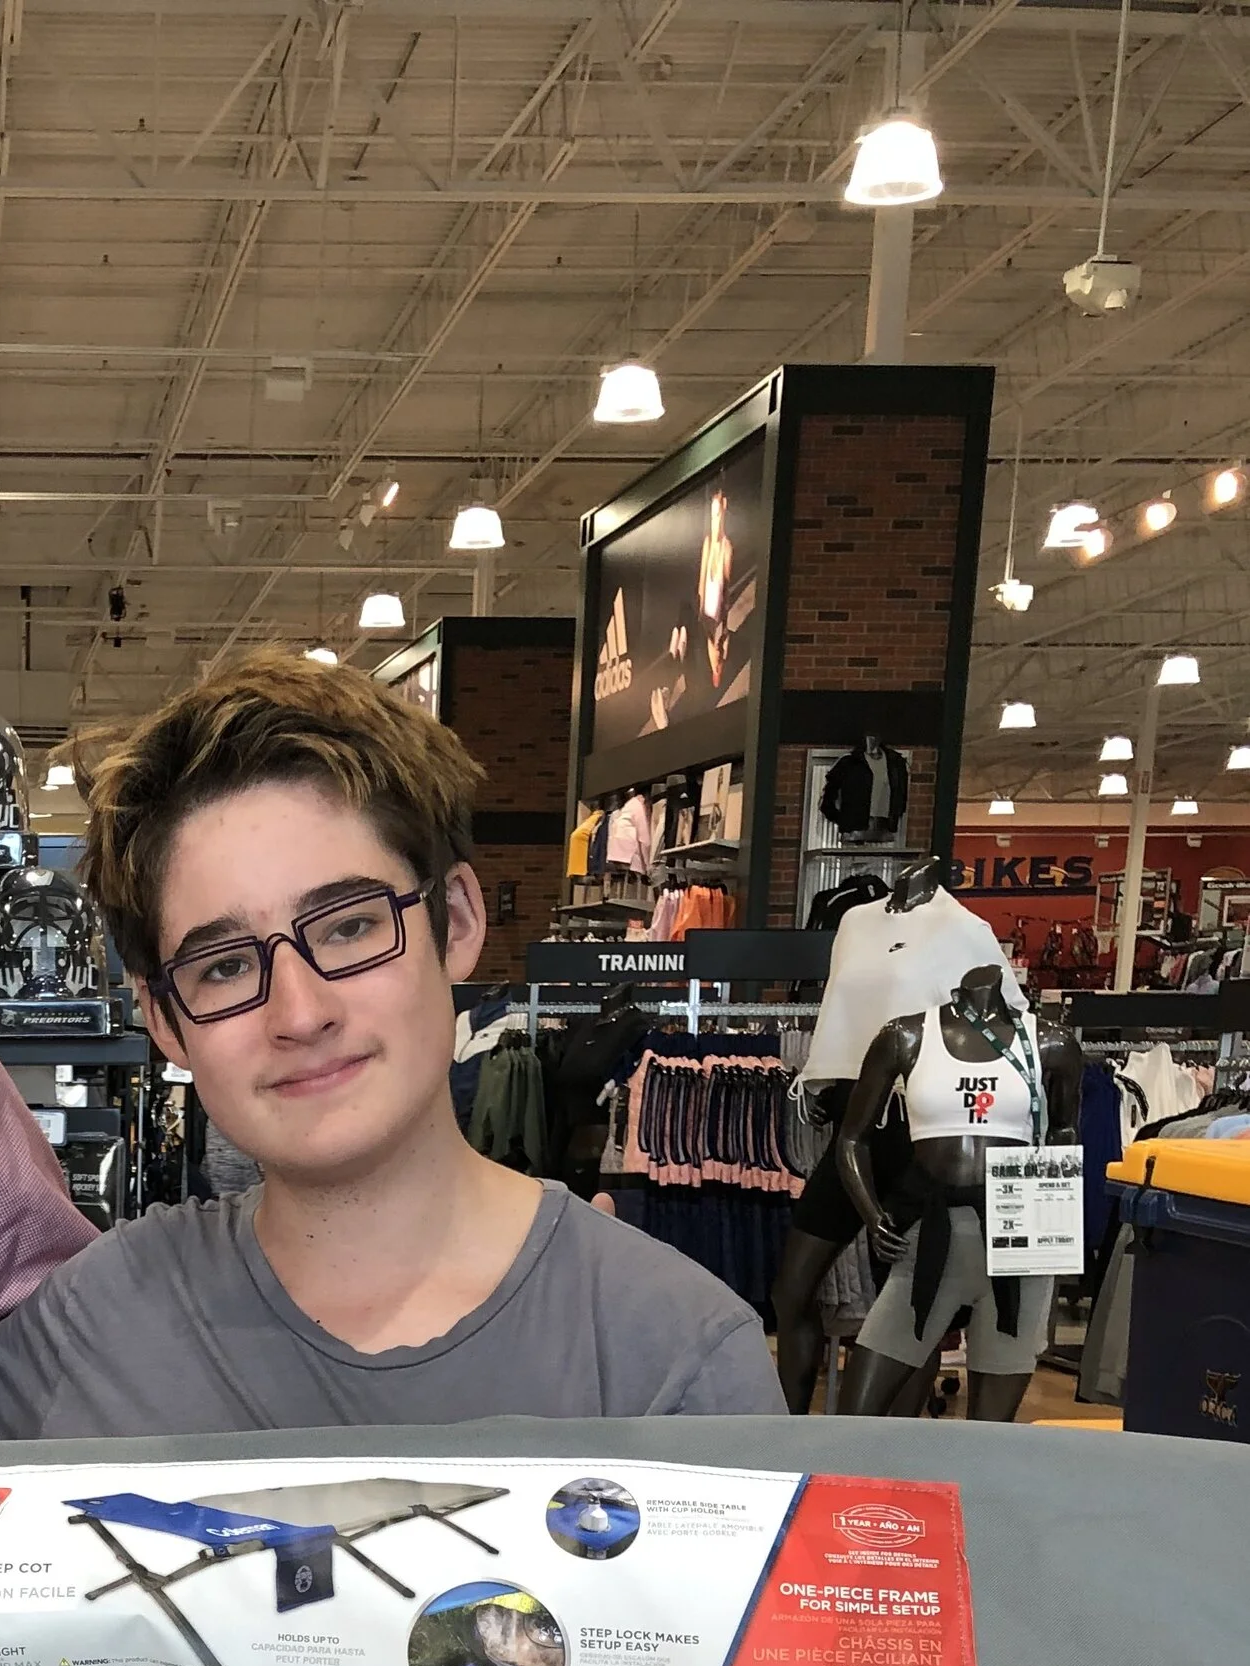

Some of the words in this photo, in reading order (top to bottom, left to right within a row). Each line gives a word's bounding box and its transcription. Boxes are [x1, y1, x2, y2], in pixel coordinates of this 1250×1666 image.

[594, 658, 632, 701] adidas
[22, 1016, 91, 1024] PREDATORS
[955, 1077, 998, 1092] JUST
[963, 1092, 994, 1108] DO
[646, 1499, 698, 1507] REMOVABLE
[721, 1503, 747, 1511] TABLE
[690, 1507, 725, 1515] HOLDER
[839, 1516, 846, 1526] 1
[847, 1519, 871, 1527] YEAR
[879, 1520, 899, 1531] AÑO
[19, 1562, 53, 1573] COT
[20, 1586, 76, 1599] FACILE
[779, 1583, 873, 1601] ONE-PIECE
[878, 1589, 940, 1604] FRAME
[800, 1599, 831, 1612] FOR
[835, 1601, 888, 1615] SIMPLE
[892, 1604, 941, 1616] SETUP
[277, 1633, 310, 1643] HOLDS
[312, 1635, 326, 1644] UP
[327, 1636, 340, 1645] TO
[580, 1627, 612, 1638] STEP
[616, 1630, 651, 1640] LOCK
[655, 1632, 700, 1645] MAKES
[838, 1634, 914, 1651] CHÂSSIS
[919, 1639, 942, 1652] EN
[251, 1643, 305, 1653] CAPACIDAD
[307, 1646, 332, 1655] PARA
[334, 1648, 366, 1657] HASTA
[580, 1639, 622, 1649] SETUP
[625, 1642, 659, 1652] EASY
[71, 1658, 111, 1666] WARNING:
[275, 1655, 300, 1664] PEUT
[303, 1656, 340, 1666] PORTER
[753, 1648, 790, 1661] UNE
[795, 1646, 846, 1663] PIÈCE
[851, 1651, 943, 1666] FACILIANT
